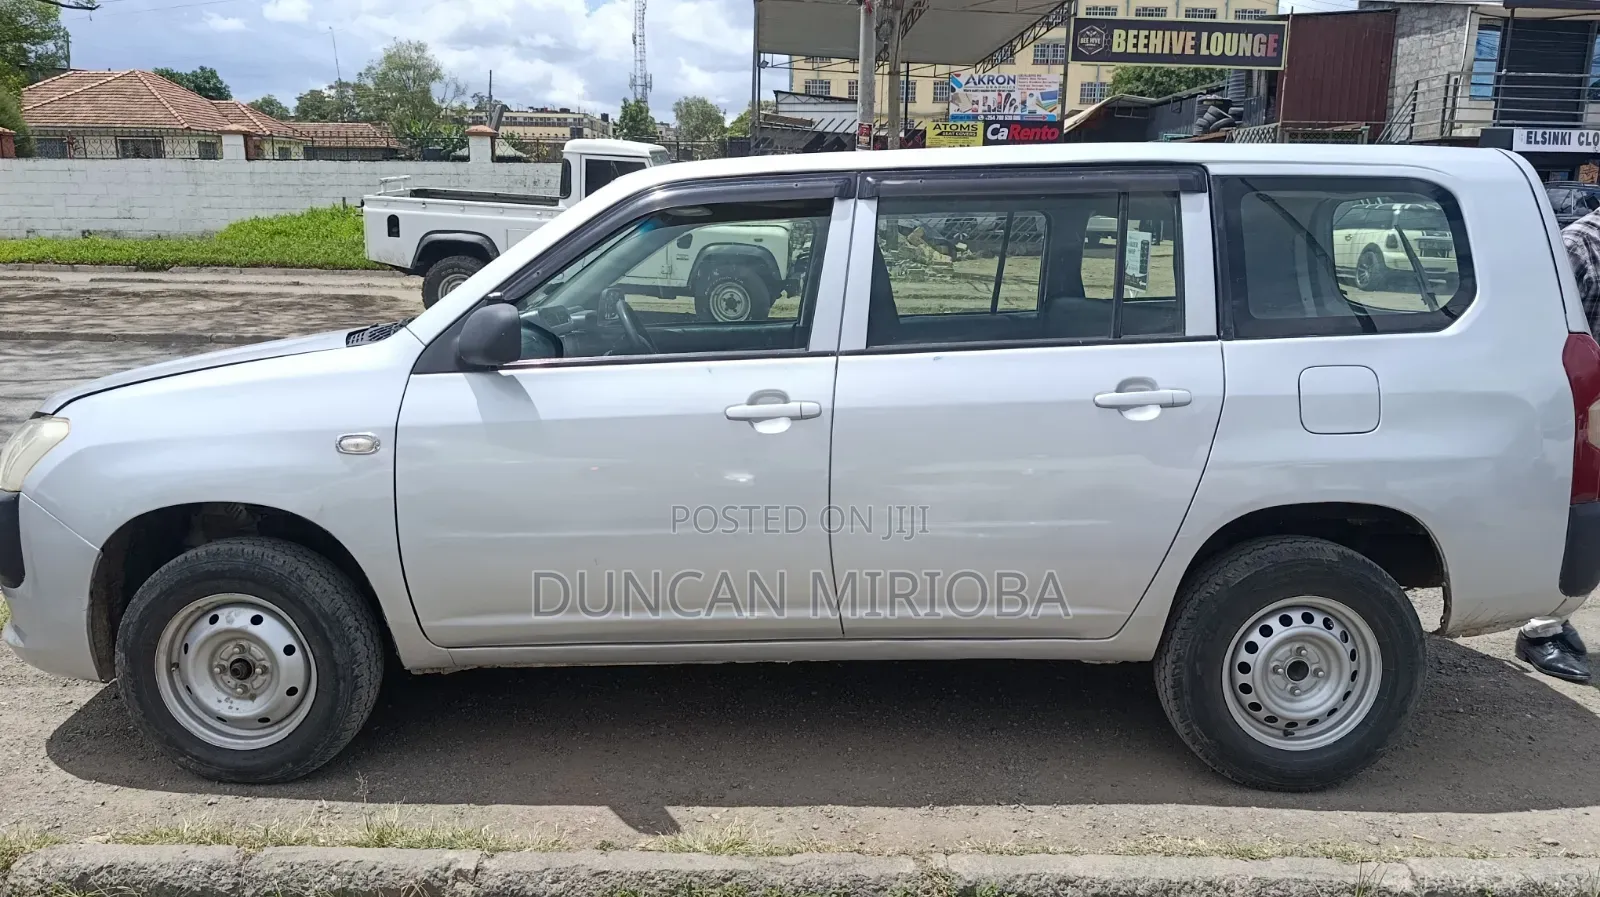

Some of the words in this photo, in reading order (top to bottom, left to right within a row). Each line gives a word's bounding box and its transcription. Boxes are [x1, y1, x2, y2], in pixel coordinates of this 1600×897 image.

[1111, 29, 1196, 55] BEEHIVE
[1200, 31, 1279, 57] LOUNGE
[964, 74, 1016, 86] AKRON
[932, 123, 978, 131] ATOMS
[986, 123, 1060, 141] CaRento
